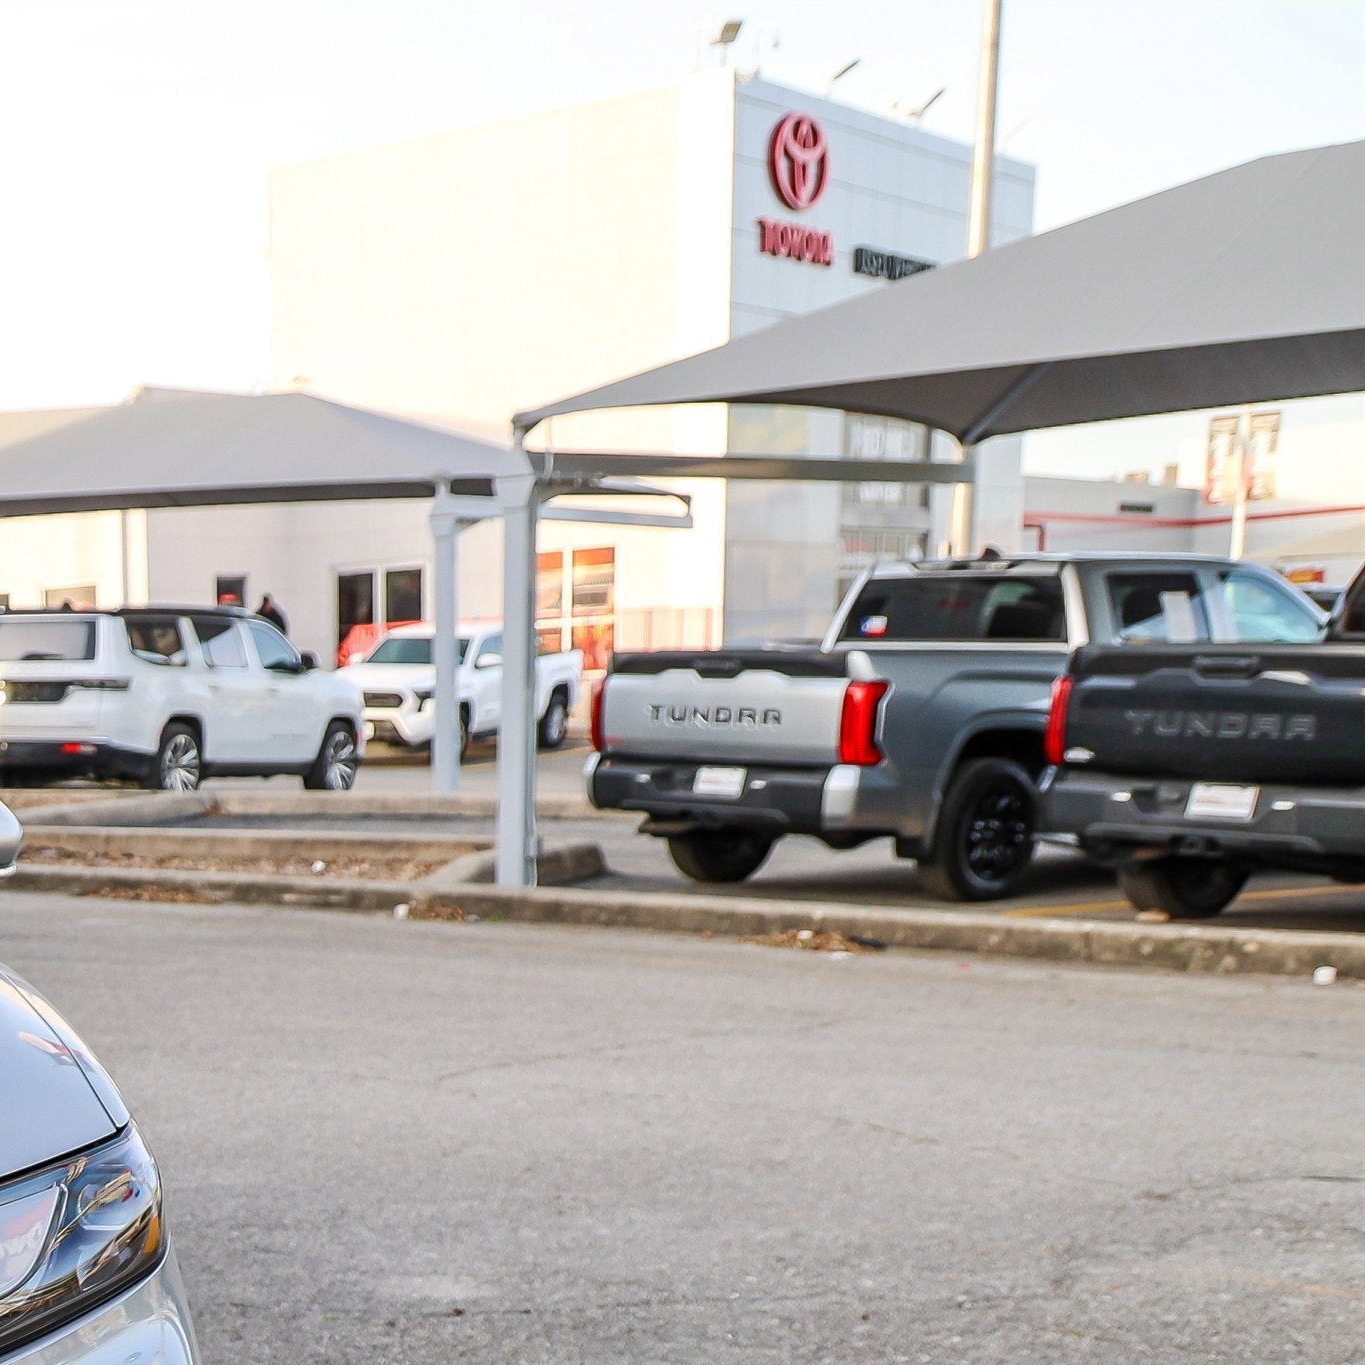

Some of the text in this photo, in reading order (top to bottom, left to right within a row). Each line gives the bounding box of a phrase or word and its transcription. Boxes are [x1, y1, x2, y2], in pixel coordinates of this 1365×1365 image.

[758, 216, 832, 267] TOYOTA
[648, 703, 785, 727] TUNDRA
[1124, 708, 1318, 741] TUNDRA
